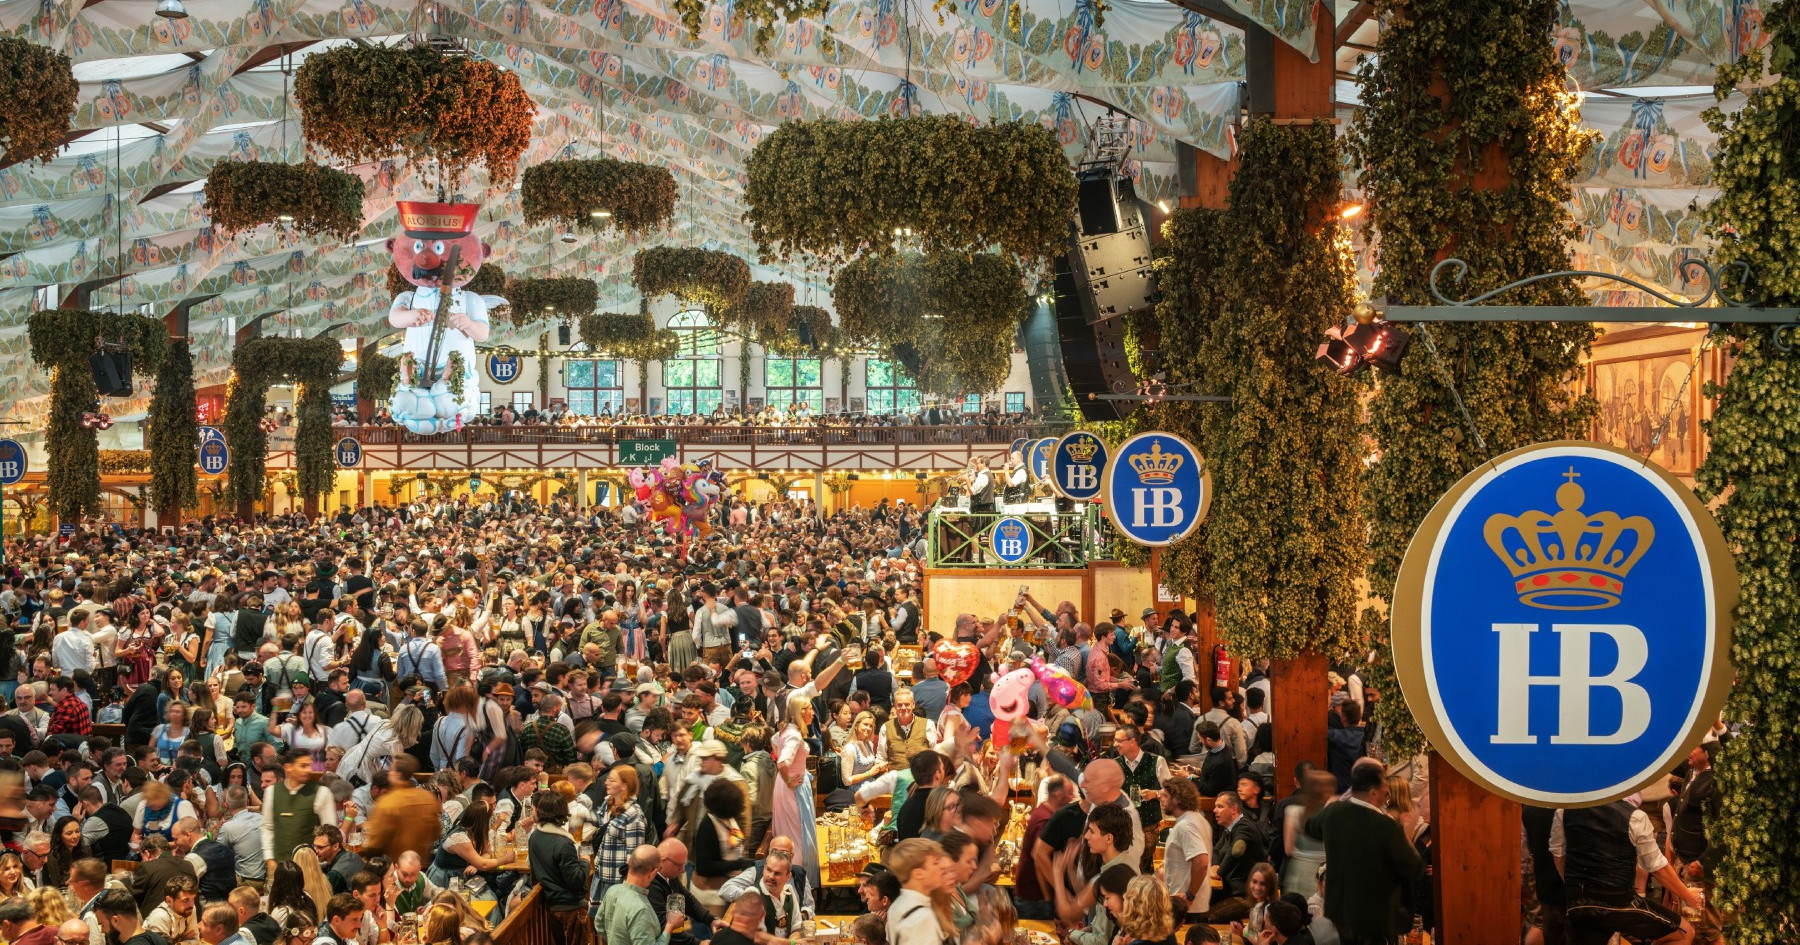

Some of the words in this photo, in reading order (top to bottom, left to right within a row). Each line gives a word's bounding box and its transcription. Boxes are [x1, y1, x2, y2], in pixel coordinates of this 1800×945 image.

[407, 216, 459, 227] ALOISIUS
[496, 363, 513, 377] HB
[635, 443, 660, 451] Block
[206, 456, 223, 470] HB
[342, 451, 356, 464] HB
[630, 453, 636, 461] K
[647, 453, 652, 461] J
[1066, 464, 1098, 490] HB
[1132, 487, 1184, 527] HB
[1000, 539, 1023, 556] HB
[1490, 623, 1652, 745] HB
